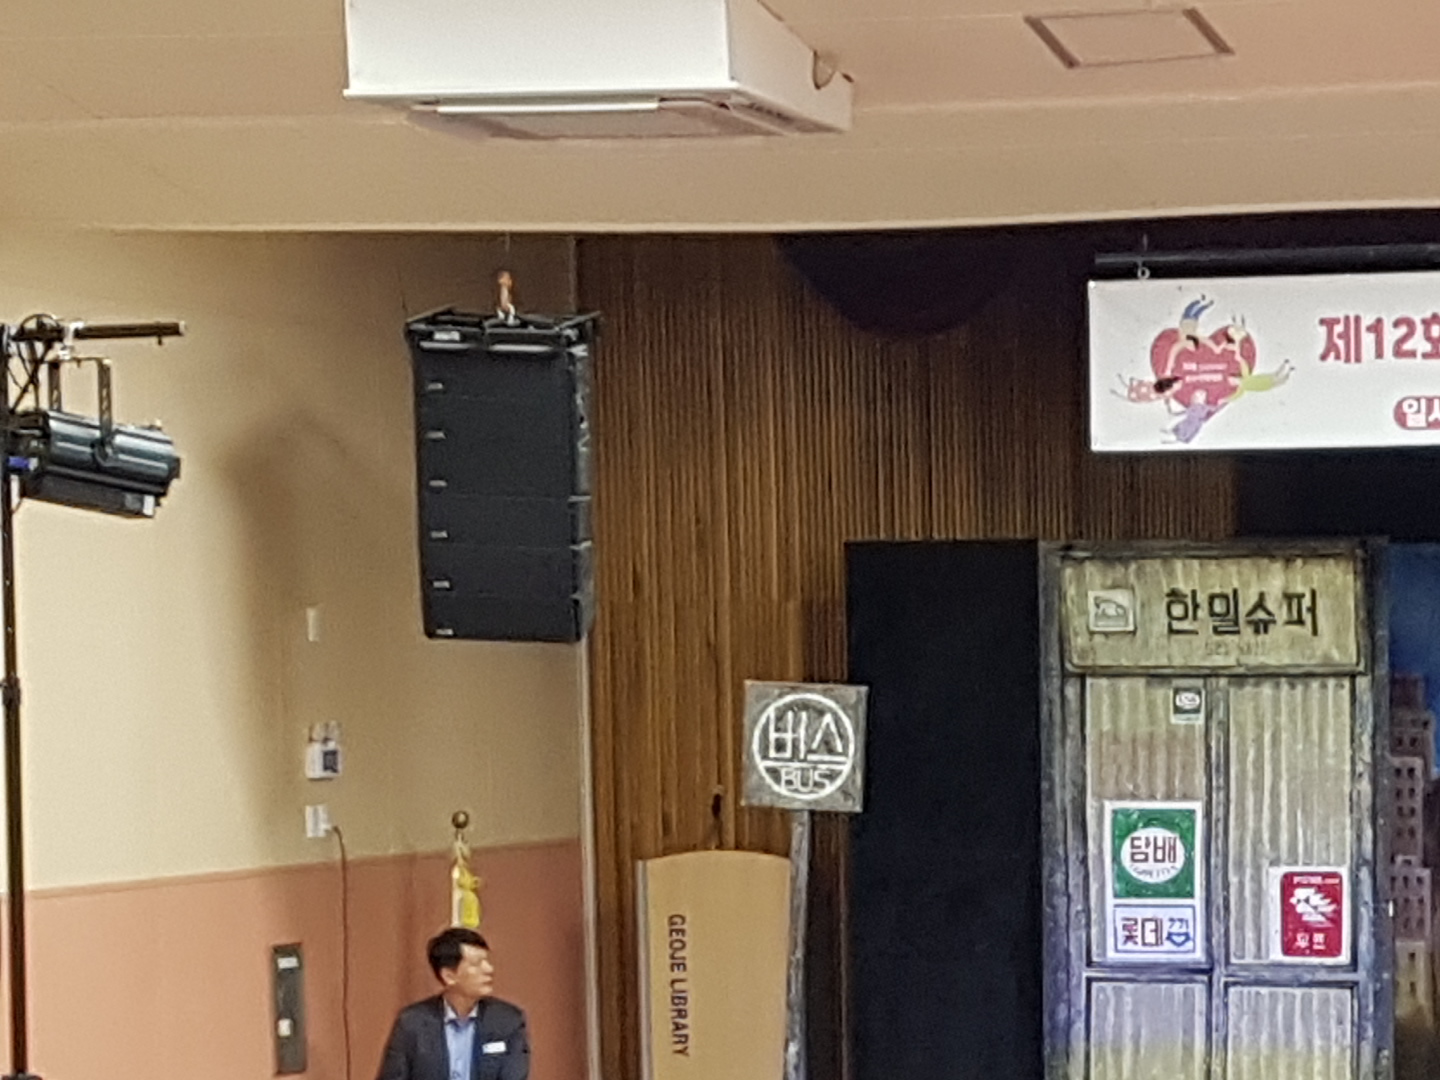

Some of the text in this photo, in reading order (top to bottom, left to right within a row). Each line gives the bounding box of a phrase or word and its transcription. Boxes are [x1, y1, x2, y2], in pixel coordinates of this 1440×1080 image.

[768, 706, 848, 761] 버스
[780, 767, 831, 793] BUS
[1129, 835, 1178, 864] 담배
[667, 913, 691, 1058] GEOJE LIBRARY
